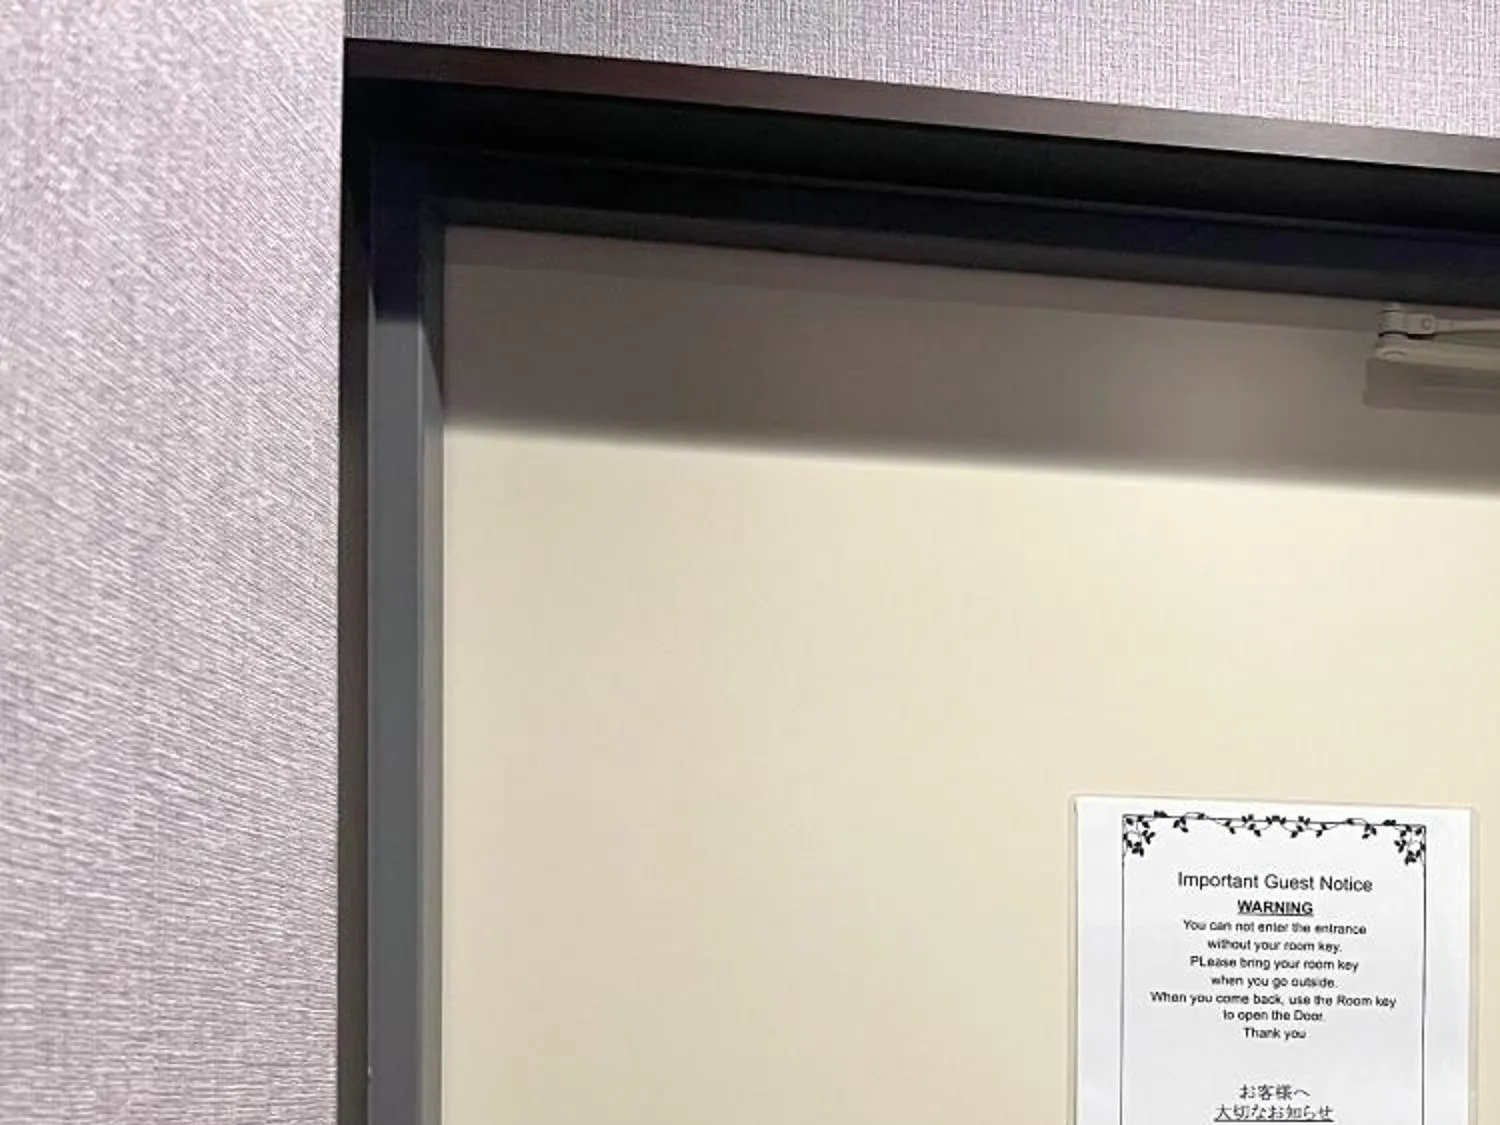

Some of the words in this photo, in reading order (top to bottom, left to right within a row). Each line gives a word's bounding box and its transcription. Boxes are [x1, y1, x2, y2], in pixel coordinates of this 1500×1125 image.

[1178, 872, 1258, 890] Important
[1264, 874, 1314, 890] Guest
[1320, 876, 1373, 892] Notice
[1237, 900, 1314, 916] WARNING
[1184, 919, 1205, 931] You
[1210, 922, 1231, 932] can
[1236, 921, 1255, 932] not
[1258, 922, 1289, 933] enter
[1292, 922, 1310, 933] the
[1315, 923, 1367, 934] entrance
[1208, 939, 1251, 950] without
[1254, 941, 1280, 953] your
[1284, 942, 1314, 951] room
[1319, 941, 1342, 954] key.
[1190, 956, 1236, 967] PLease
[1241, 958, 1270, 970] bring
[1274, 960, 1300, 971] your
[1304, 961, 1334, 970] room
[1338, 960, 1359, 972] key
[1211, 976, 1243, 986] when
[1247, 978, 1268, 989] you
[1272, 978, 1288, 989] go
[1292, 977, 1338, 988] outside.
[1150, 991, 1187, 1003] When
[1190, 994, 1212, 1005] you
[1216, 995, 1249, 1005] come
[1253, 994, 1284, 1006] back,
[1289, 996, 1310, 1005] use
[1314, 995, 1332, 1005] the
[1337, 995, 1372, 1006] Room
[1375, 996, 1396, 1008] key
[1223, 1010, 1234, 1020] to
[1238, 1012, 1268, 1023] open
[1271, 1010, 1290, 1020] the
[1294, 1010, 1325, 1021] Door.
[1244, 1027, 1280, 1039] Thank
[1284, 1029, 1306, 1040] you
[1239, 1084, 1311, 1100] お客様へ
[1214, 1105, 1334, 1122] 大切なお知らせ
